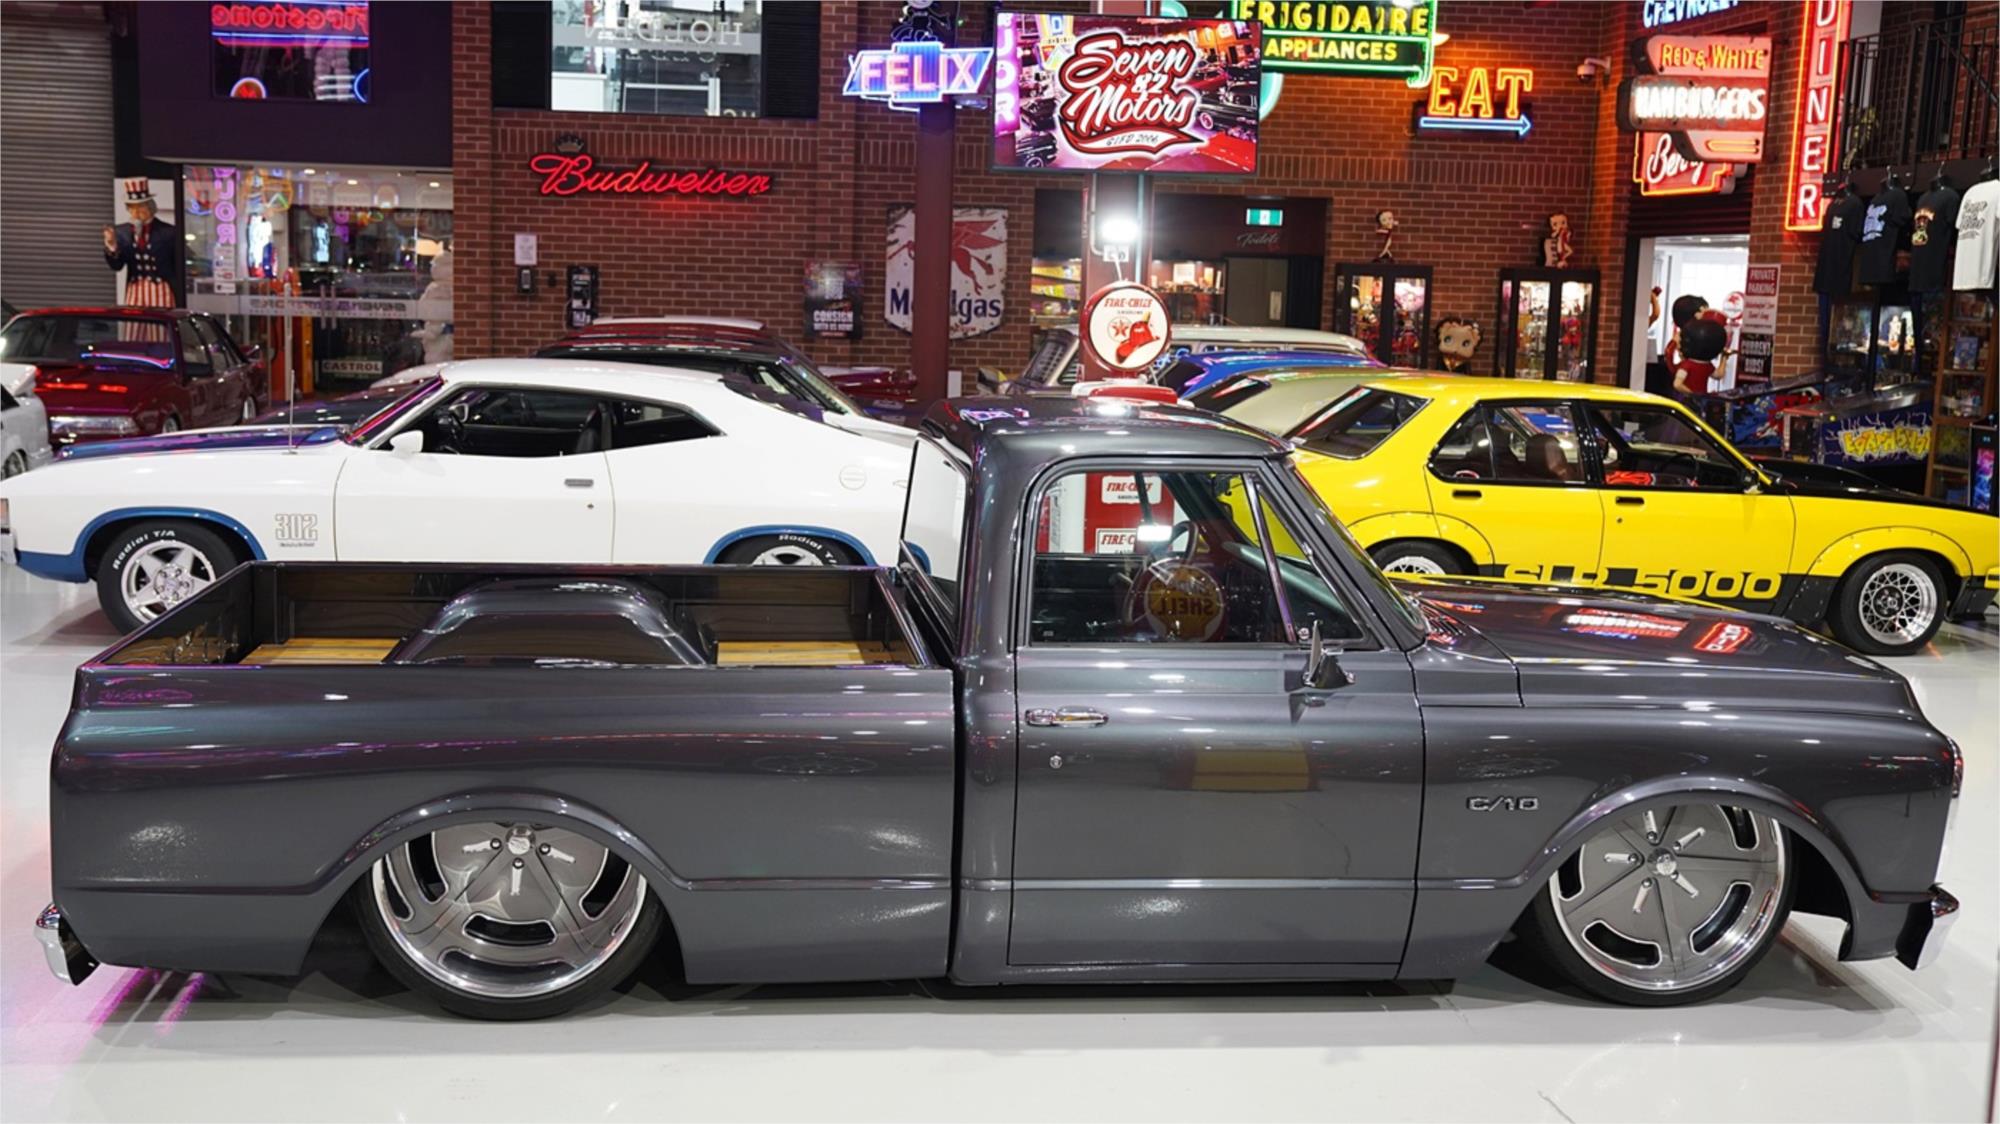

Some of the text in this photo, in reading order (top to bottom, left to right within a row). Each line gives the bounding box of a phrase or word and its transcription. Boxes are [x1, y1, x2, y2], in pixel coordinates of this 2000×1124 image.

[1239, 2, 1429, 36] FRIGIDAIRE
[1065, 38, 1190, 89] Seven
[1264, 38, 1398, 60] APPLIANCES
[1661, 43, 1765, 70] RED & WHITE
[860, 53, 977, 92] FELIX
[1131, 73, 1169, 94] 82
[1067, 84, 1195, 133] Motors
[1428, 66, 1533, 119] EAT
[1634, 86, 1766, 120] HAMBURGERS
[1797, 0, 1836, 219] DINER
[530, 154, 771, 195] Budweiser
[890, 288, 1001, 324] Mlgas
[323, 362, 381, 372] CASTROL
[275, 513, 318, 542] 302
[112, 530, 176, 570] Radial T/A
[778, 534, 838, 566] Radial T/
[1633, 567, 1782, 600] 5000
[1467, 796, 1538, 812] C/10
